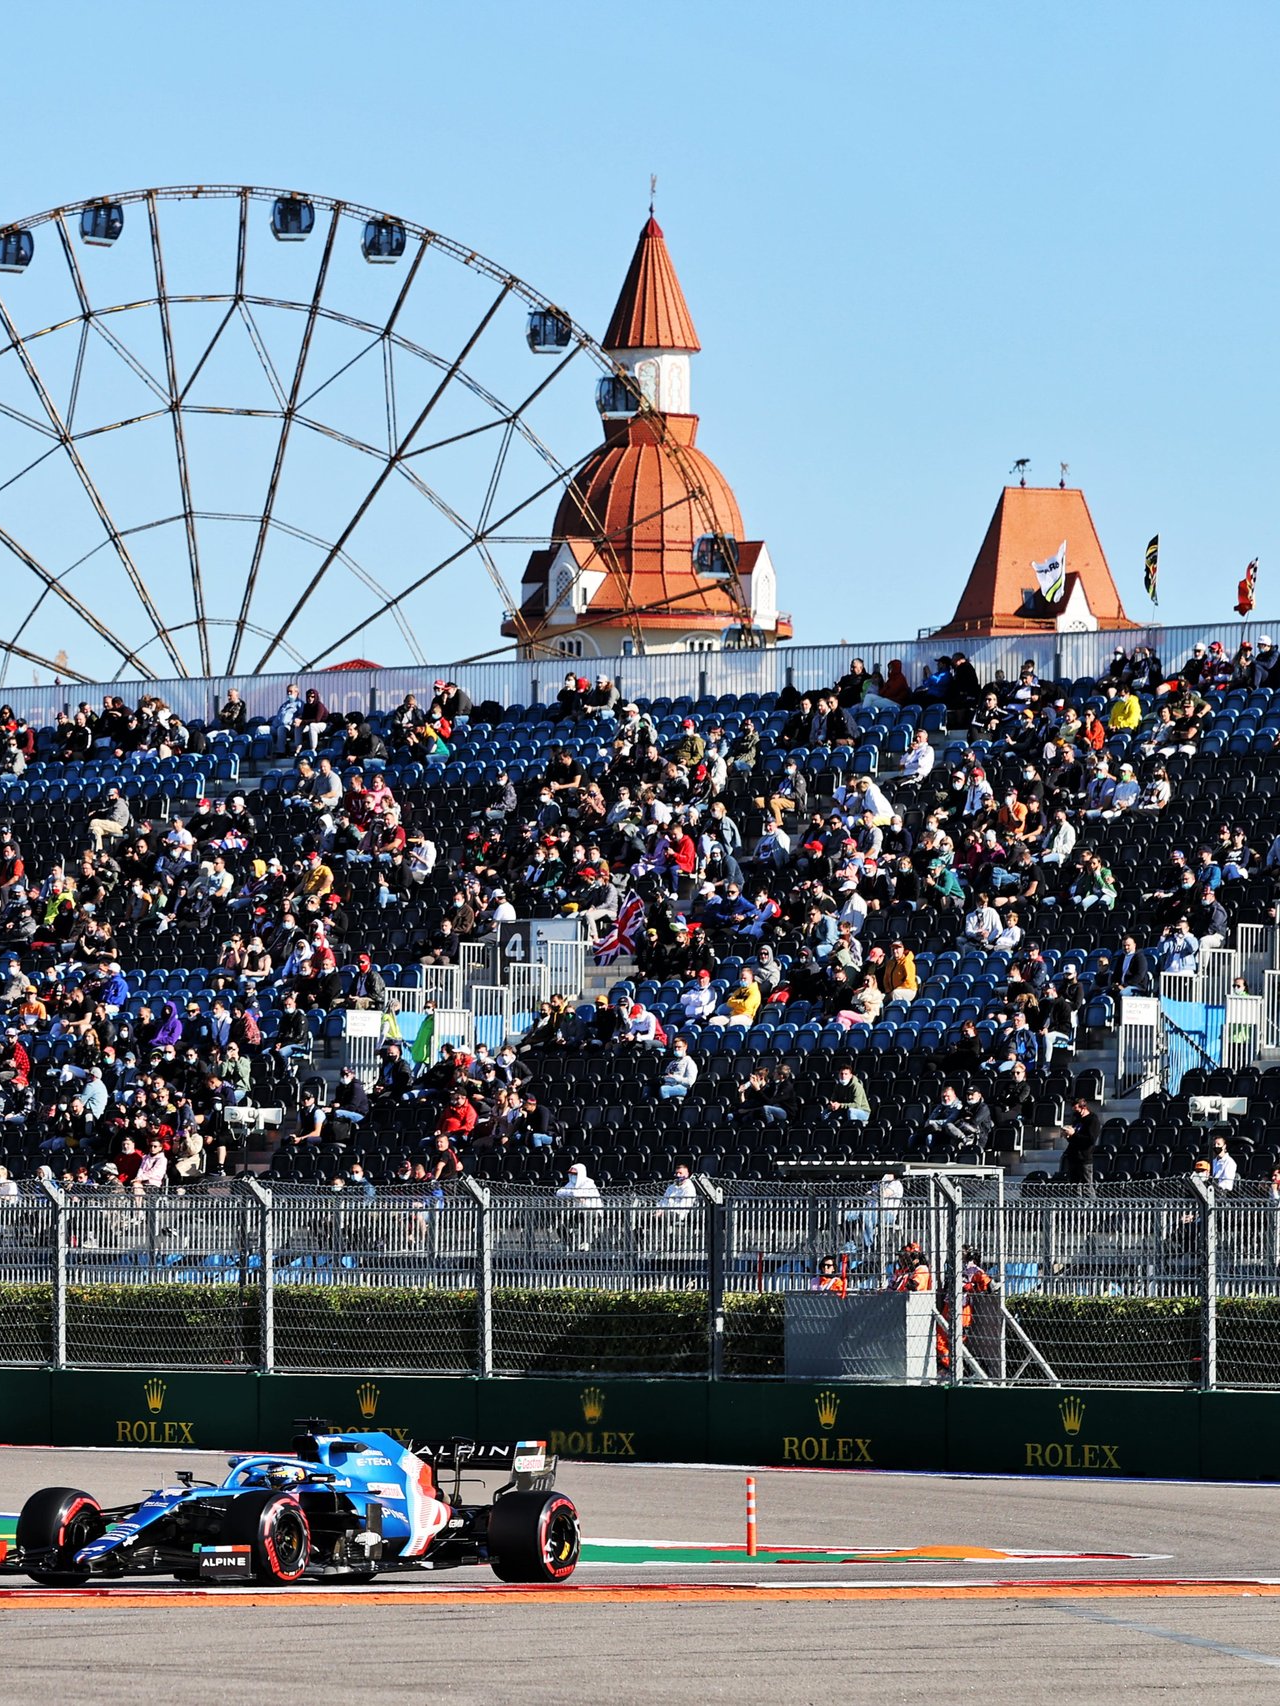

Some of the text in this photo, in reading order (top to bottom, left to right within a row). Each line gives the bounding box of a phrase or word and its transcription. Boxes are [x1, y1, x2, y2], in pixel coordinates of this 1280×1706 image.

[505, 932, 525, 961] 4
[116, 1420, 195, 1444] ROLEX
[550, 1430, 635, 1455] ROLEX
[356, 1457, 392, 1466] E-TECH
[415, 1445, 510, 1459] ALPIN
[783, 1437, 873, 1462] ROLEX
[1024, 1443, 1120, 1469] ROLEX
[202, 1557, 246, 1567] ALPINE
